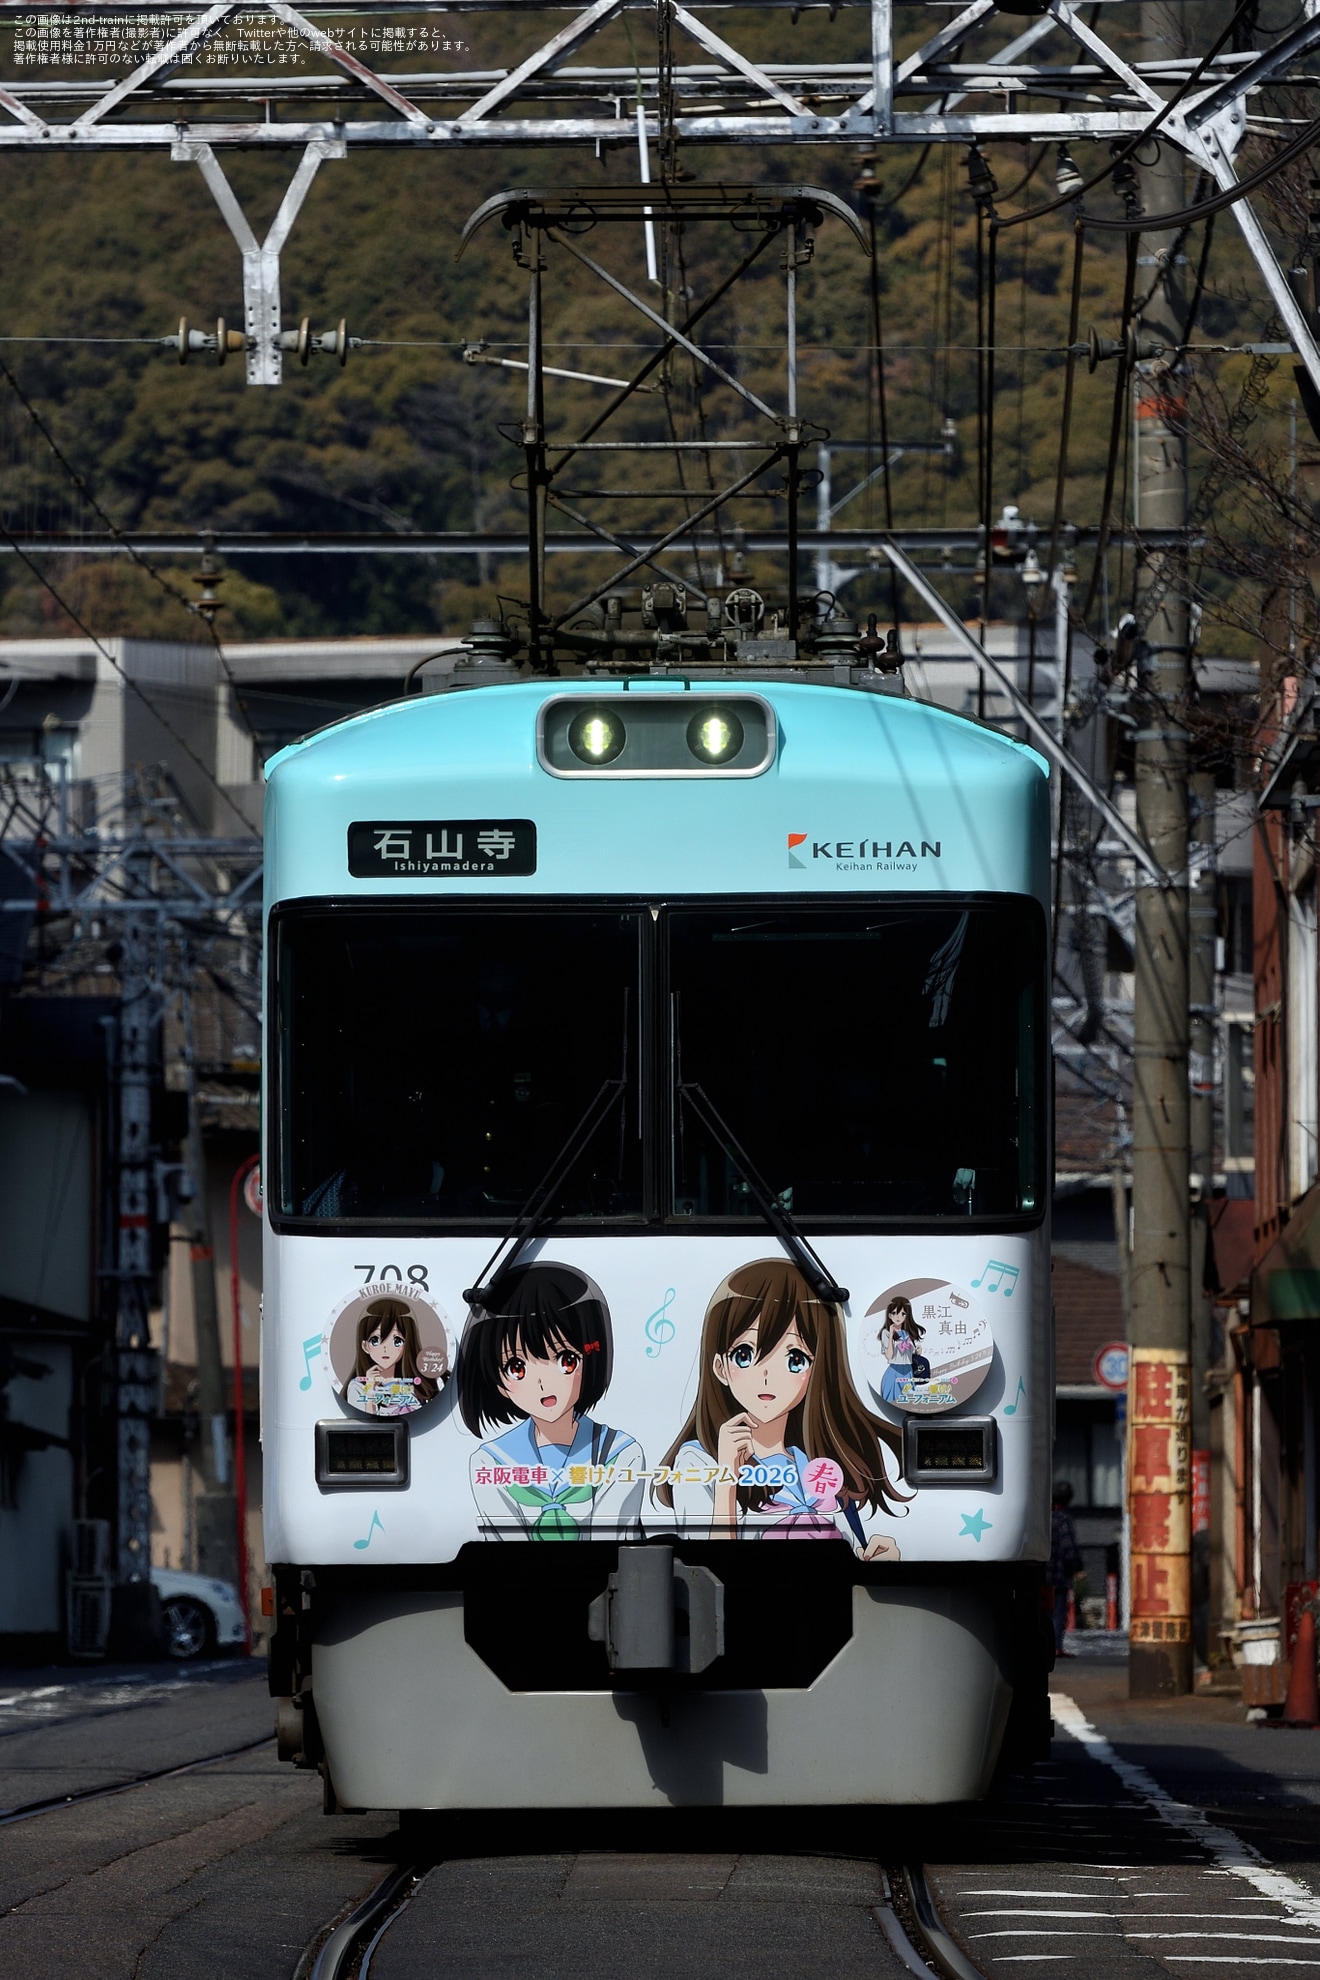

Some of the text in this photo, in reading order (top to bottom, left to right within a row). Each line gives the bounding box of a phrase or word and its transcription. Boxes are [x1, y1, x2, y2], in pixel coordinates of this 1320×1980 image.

[373, 829, 516, 860] 石山寺
[812, 839, 942, 858] KEIHAN
[393, 860, 496, 874] Ishiyamadera
[836, 861, 919, 874] Keihan Railway
[358, 1282, 392, 1299] KUROE
[922, 1304, 953, 1320] 黒江
[938, 1320, 967, 1336] 真由
[1106, 1355, 1128, 1379] 30
[897, 1394, 956, 1404] ユーフォニアム
[807, 1463, 838, 1495] 春
[1133, 1361, 1173, 1613] 駐車禁止
